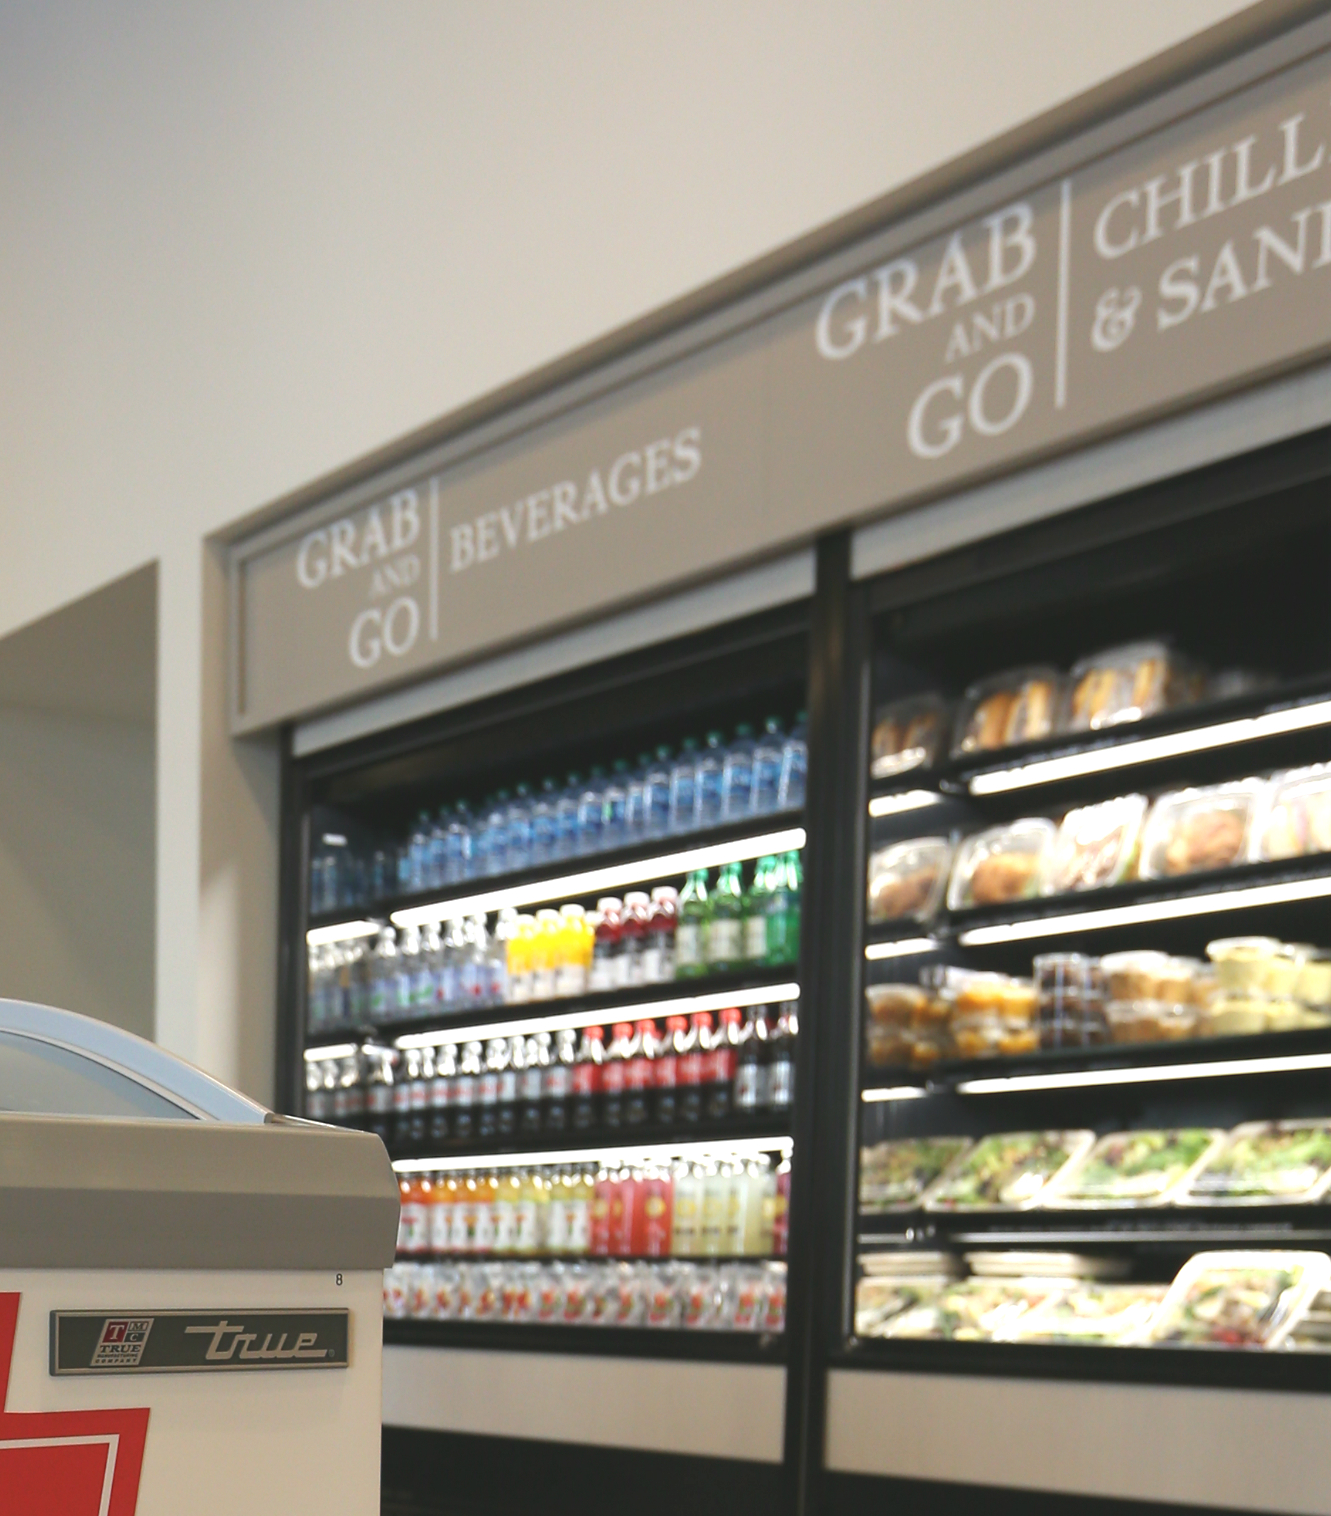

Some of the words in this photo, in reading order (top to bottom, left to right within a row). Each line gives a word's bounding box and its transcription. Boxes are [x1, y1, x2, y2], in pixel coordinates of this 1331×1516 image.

[1093, 100, 1331, 260] CHILL
[814, 201, 1038, 361] GRAB
[944, 292, 1036, 364] AND
[1090, 285, 1143, 351] &
[906, 352, 1034, 459] GO
[449, 427, 702, 573] BEVERAGES
[296, 487, 421, 590] GRAB
[370, 553, 421, 596] AND
[348, 597, 420, 668] GO
[336, 1273, 343, 1286] 8
[100, 1344, 142, 1353] TRUE
[184, 1320, 328, 1360] true
